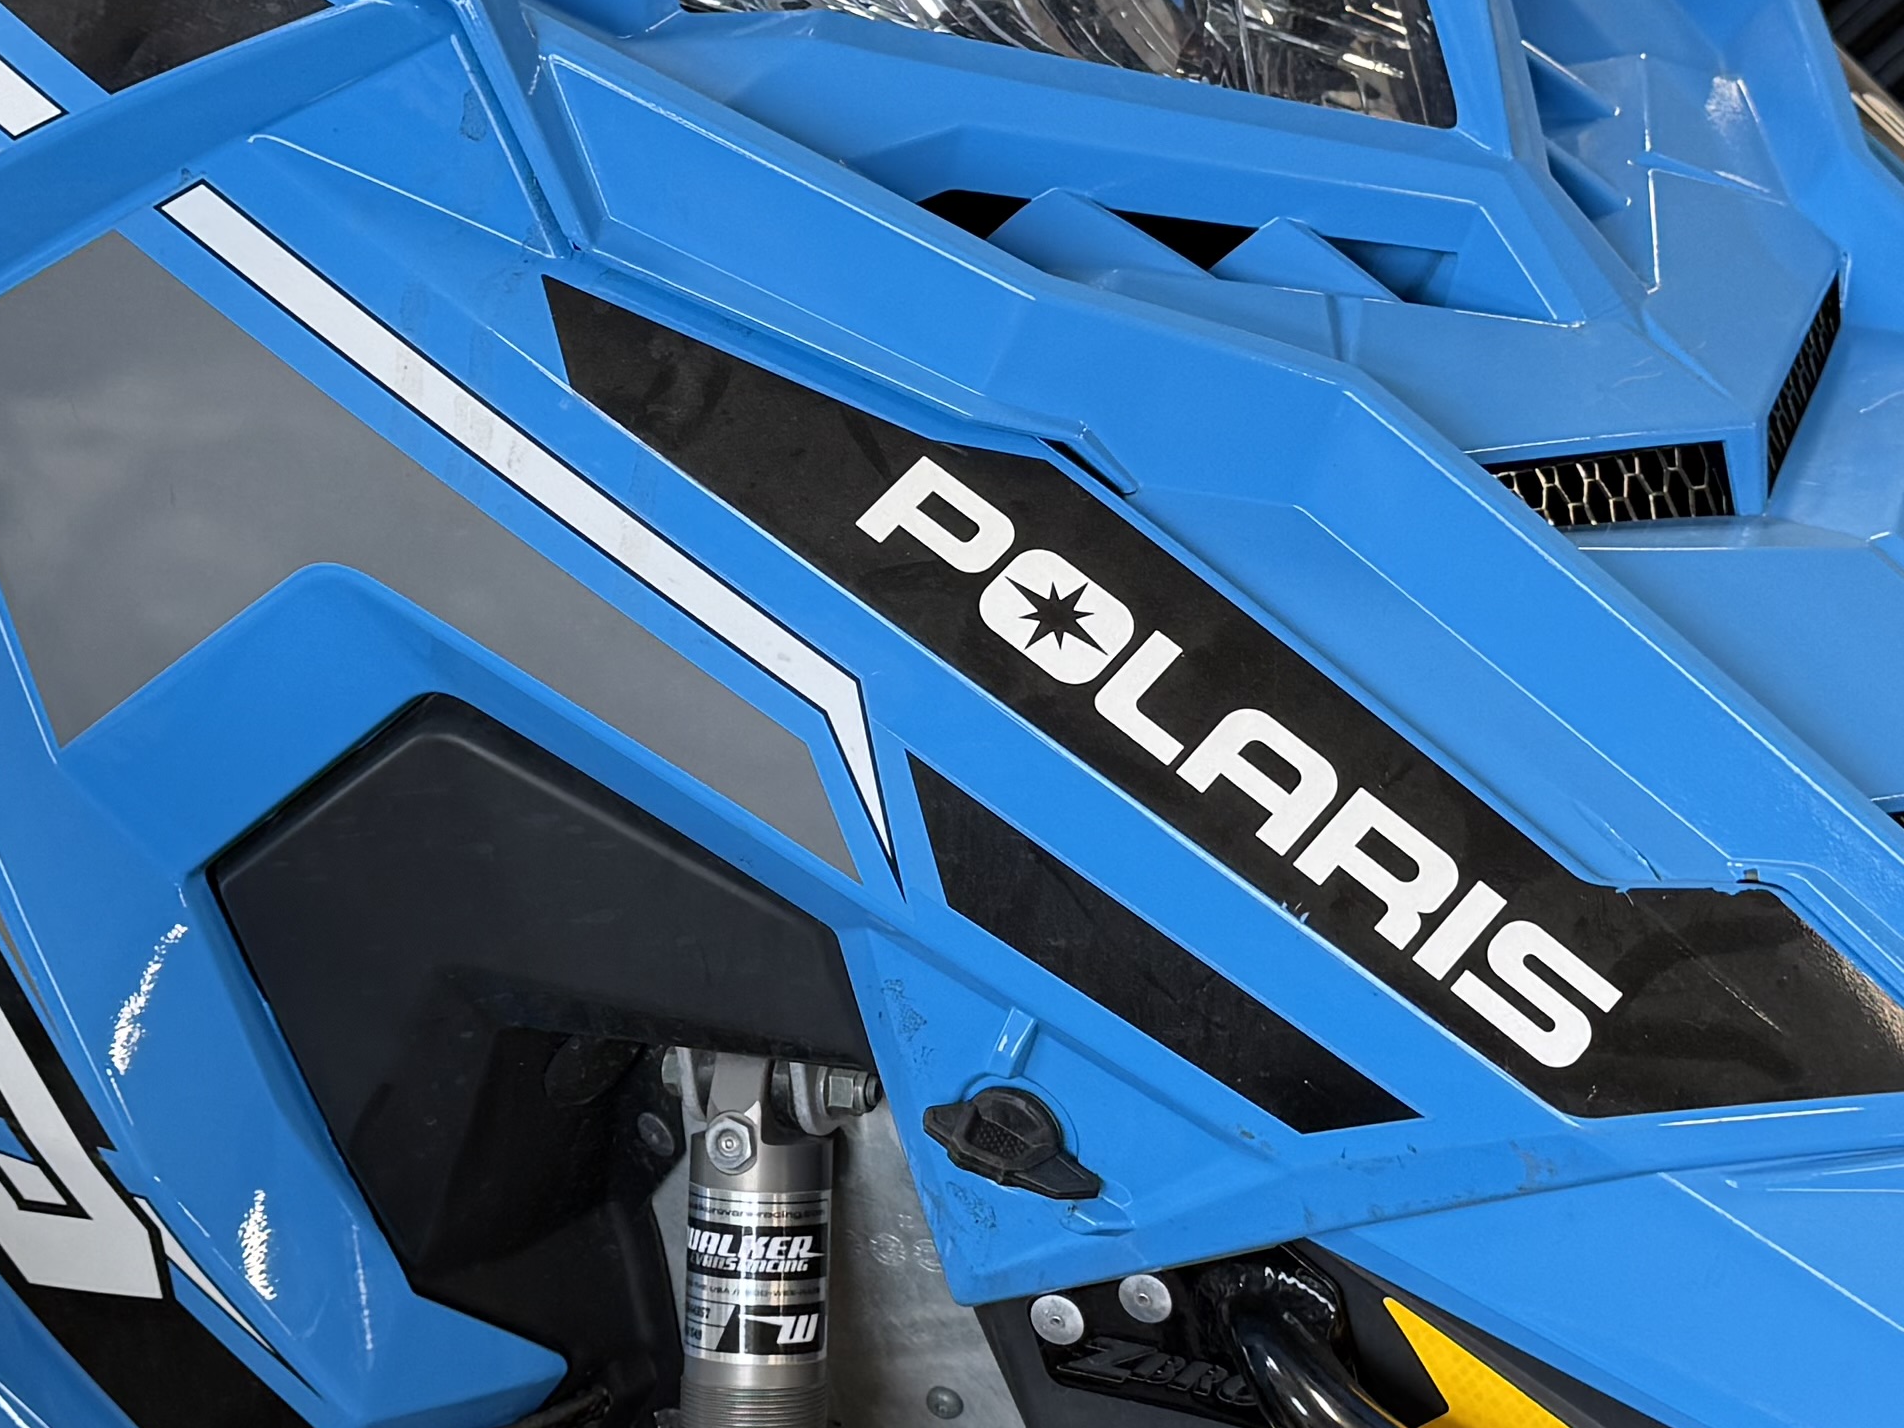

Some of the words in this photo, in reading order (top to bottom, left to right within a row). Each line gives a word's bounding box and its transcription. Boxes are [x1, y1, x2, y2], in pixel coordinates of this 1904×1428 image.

[854, 454, 1627, 1070] POLARIS
[687, 1226, 826, 1260] WALKER
[690, 1253, 738, 1269] EVANS
[738, 1257, 809, 1274] RACING
[1056, 1336, 1258, 1406] ZBRO
